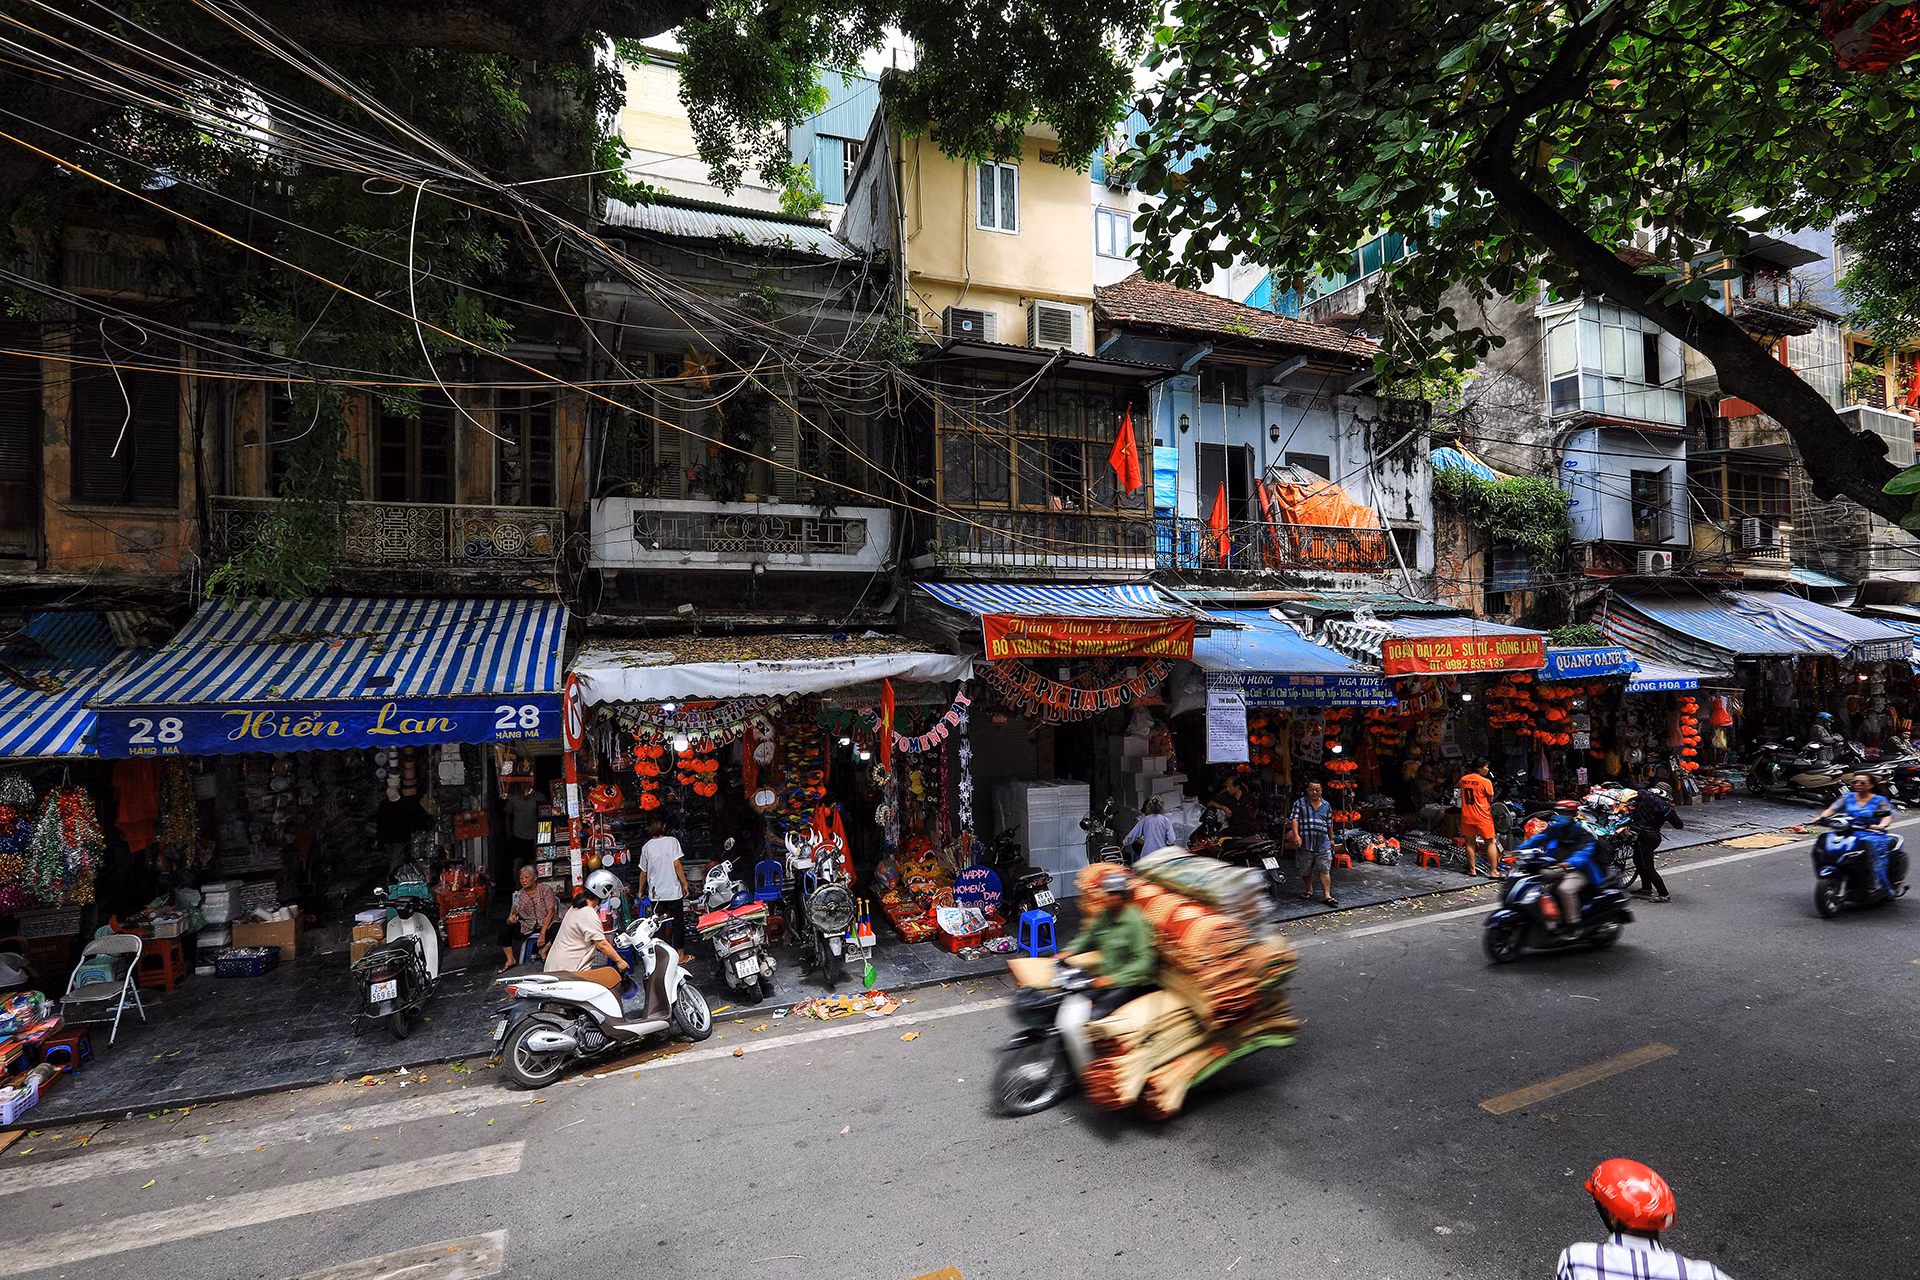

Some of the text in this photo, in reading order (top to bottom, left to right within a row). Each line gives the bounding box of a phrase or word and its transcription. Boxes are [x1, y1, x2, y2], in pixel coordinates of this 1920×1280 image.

[1097, 623, 1112, 634] 24
[992, 634, 1009, 656] ĐỒ
[1010, 639, 1050, 654] TRANG
[1053, 637, 1073, 654] TRÍ
[1075, 639, 1105, 655] SINH
[1435, 643, 1453, 657] 22A
[1445, 659, 1469, 671] 0982
[1470, 658, 1487, 669] 835
[1489, 657, 1505, 669] 133
[1556, 653, 1593, 671] QUANG
[1594, 651, 1624, 667] OANH
[997, 657, 1063, 704] HAPPY
[1068, 657, 1177, 711] HALLOWEEN
[1338, 677, 1357, 686] NGA
[1658, 681, 1681, 690] HOA
[1685, 681, 1698, 689] 18
[945, 691, 972, 727] DAY
[220, 702, 458, 741] Hiển Lan
[495, 704, 540, 730] 28
[128, 717, 184, 744] 28
[962, 869, 990, 880] HAPPY
[953, 882, 986, 894] WOMEN'S
[983, 891, 1001, 901] DAY
